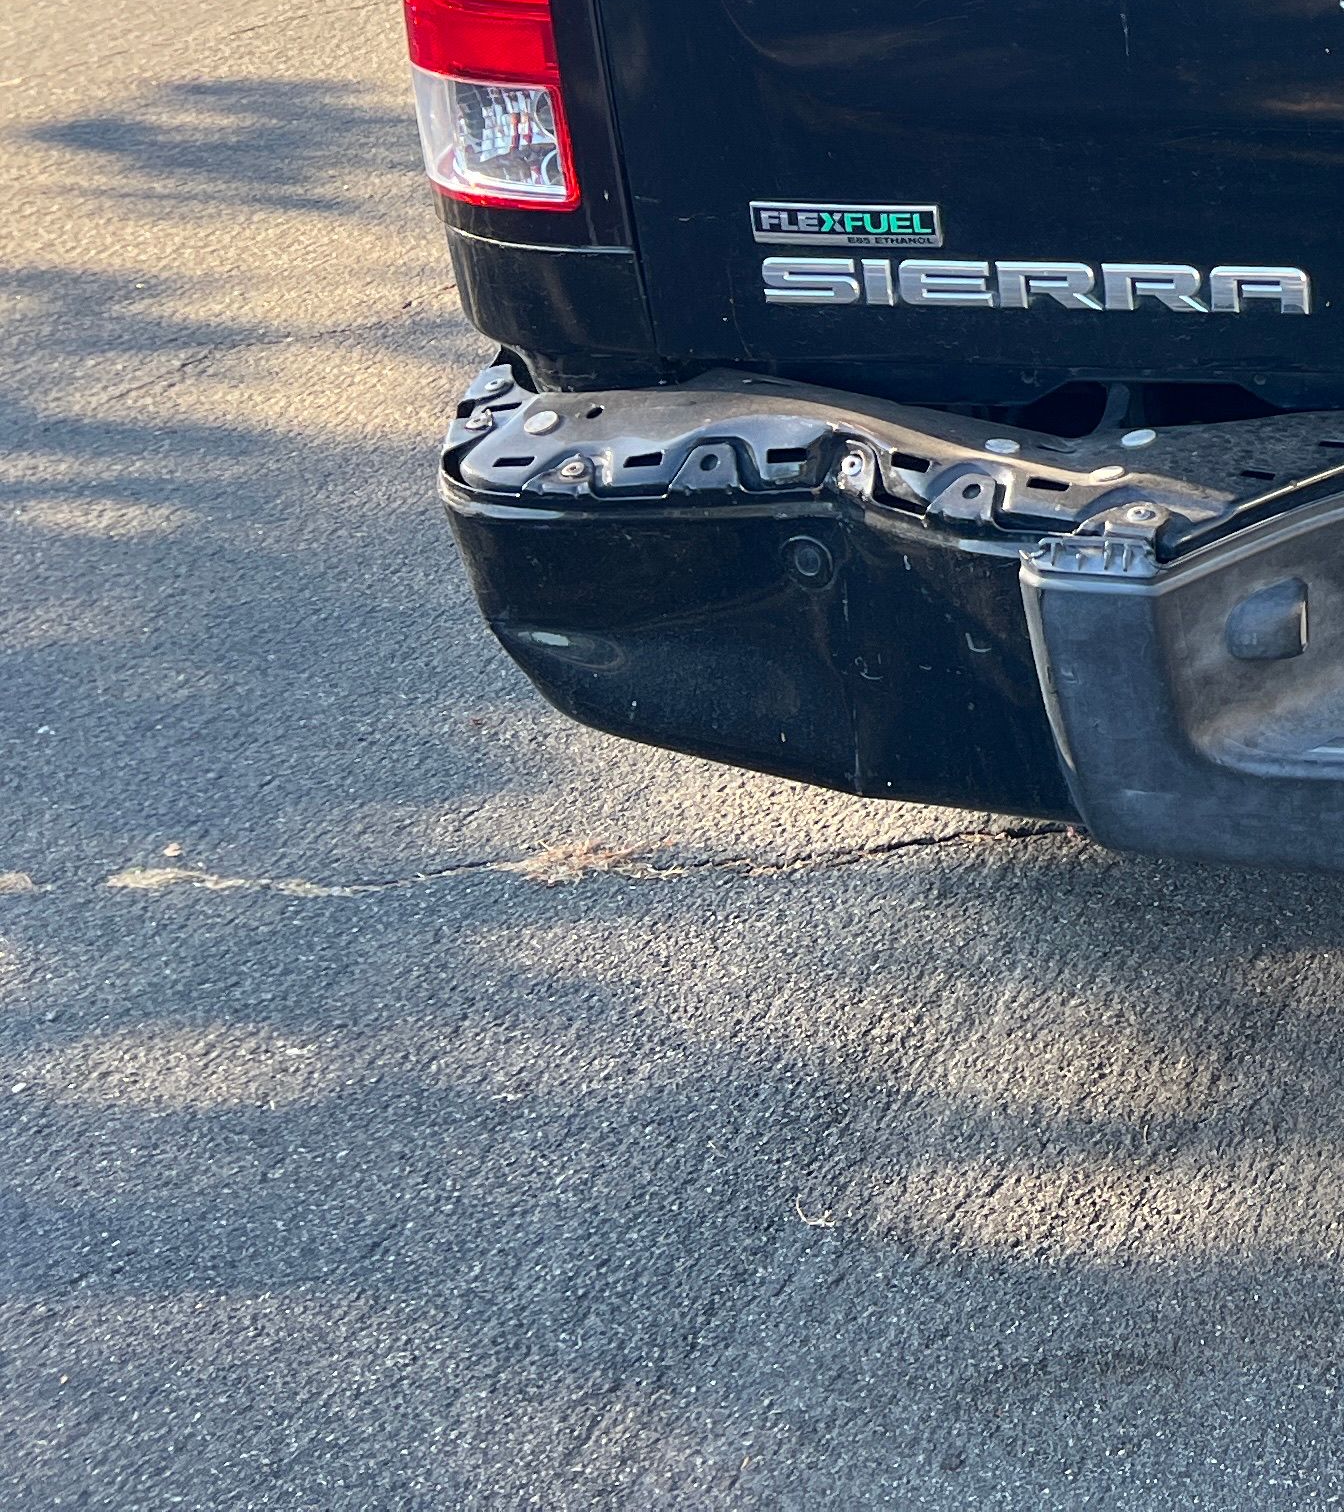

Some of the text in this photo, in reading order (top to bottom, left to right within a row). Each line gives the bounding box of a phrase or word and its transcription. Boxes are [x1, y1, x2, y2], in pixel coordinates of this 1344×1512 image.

[759, 209, 933, 234] FLEXFUEL
[846, 236, 934, 245] E85 ETHANOL
[762, 256, 1311, 315] SIERRA
